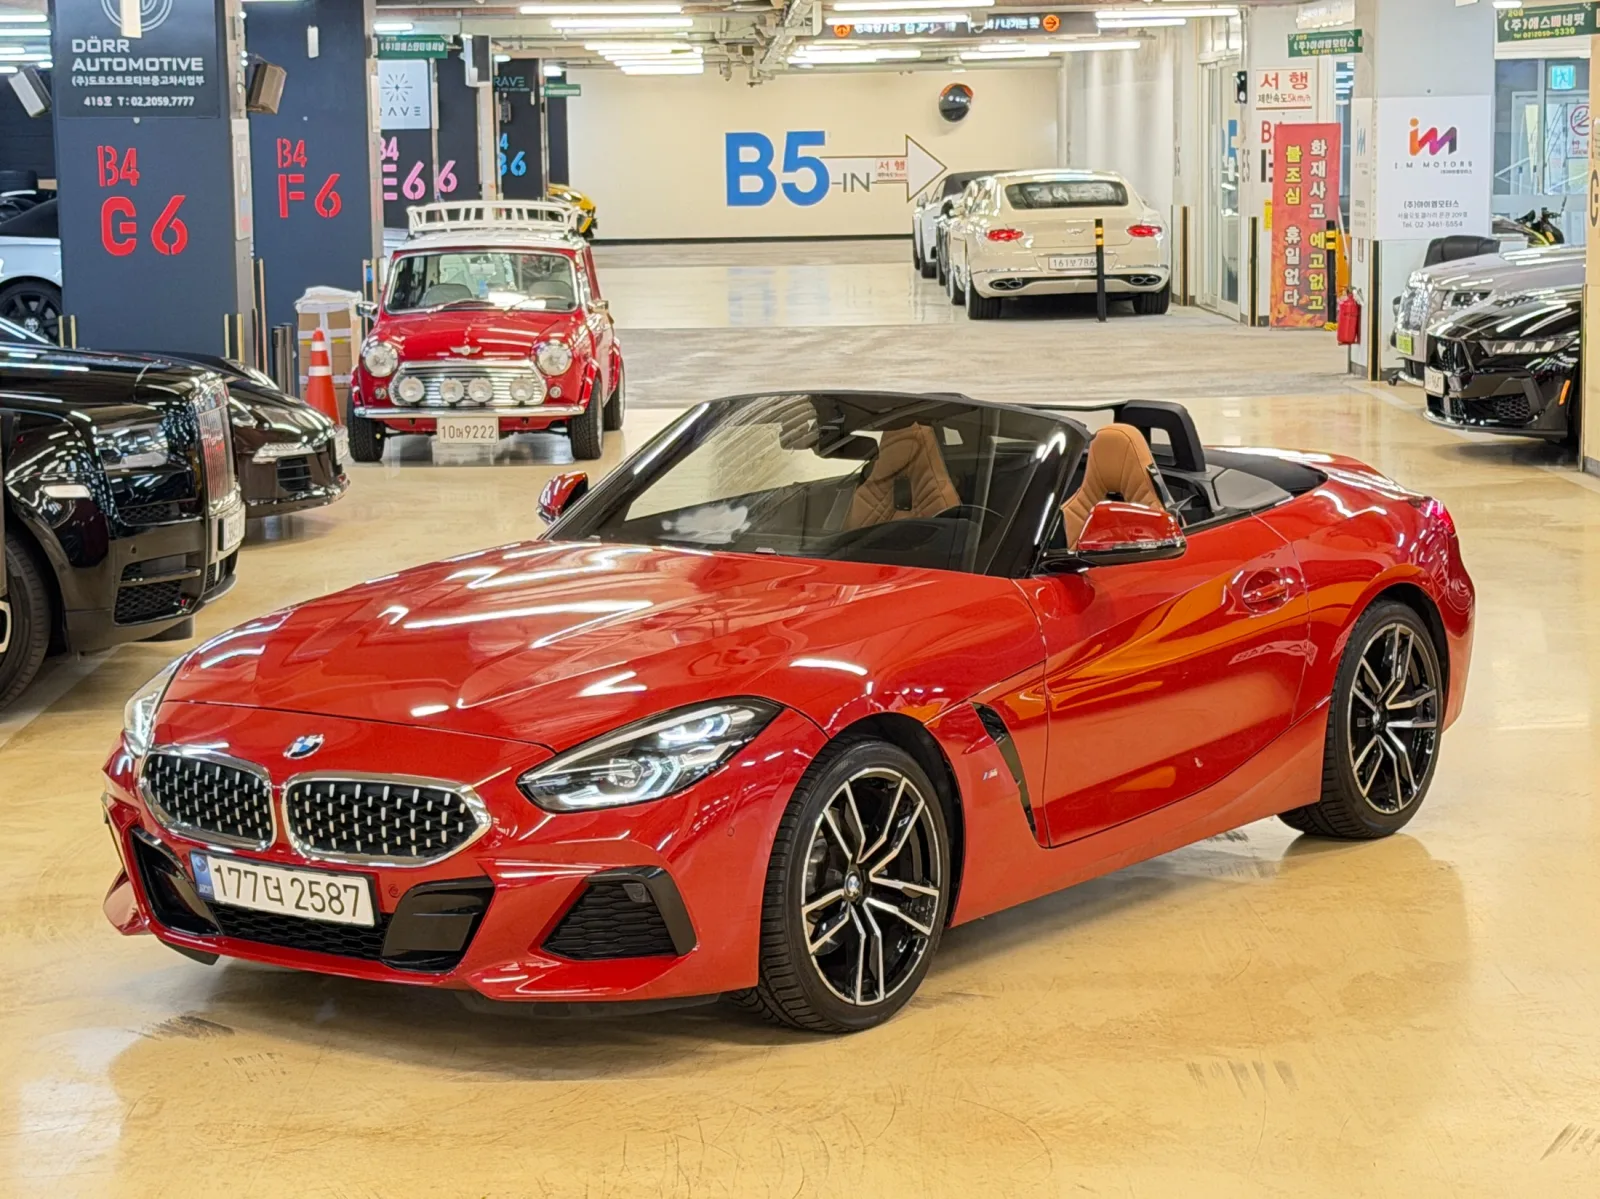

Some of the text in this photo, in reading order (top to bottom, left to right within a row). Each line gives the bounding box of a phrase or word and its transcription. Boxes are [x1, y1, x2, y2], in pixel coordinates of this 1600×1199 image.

[72, 36, 130, 53] DÖRR
[72, 57, 204, 72] AUTOMOTIVE
[97, 145, 140, 187] B4
[276, 138, 307, 168] B4
[725, 131, 830, 207] B5
[842, 172, 870, 193] IN
[1309, 138, 1328, 219] 화재사고
[1283, 144, 1303, 307] 불조심 휴일없다
[214, 864, 359, 917] 177더 2587
